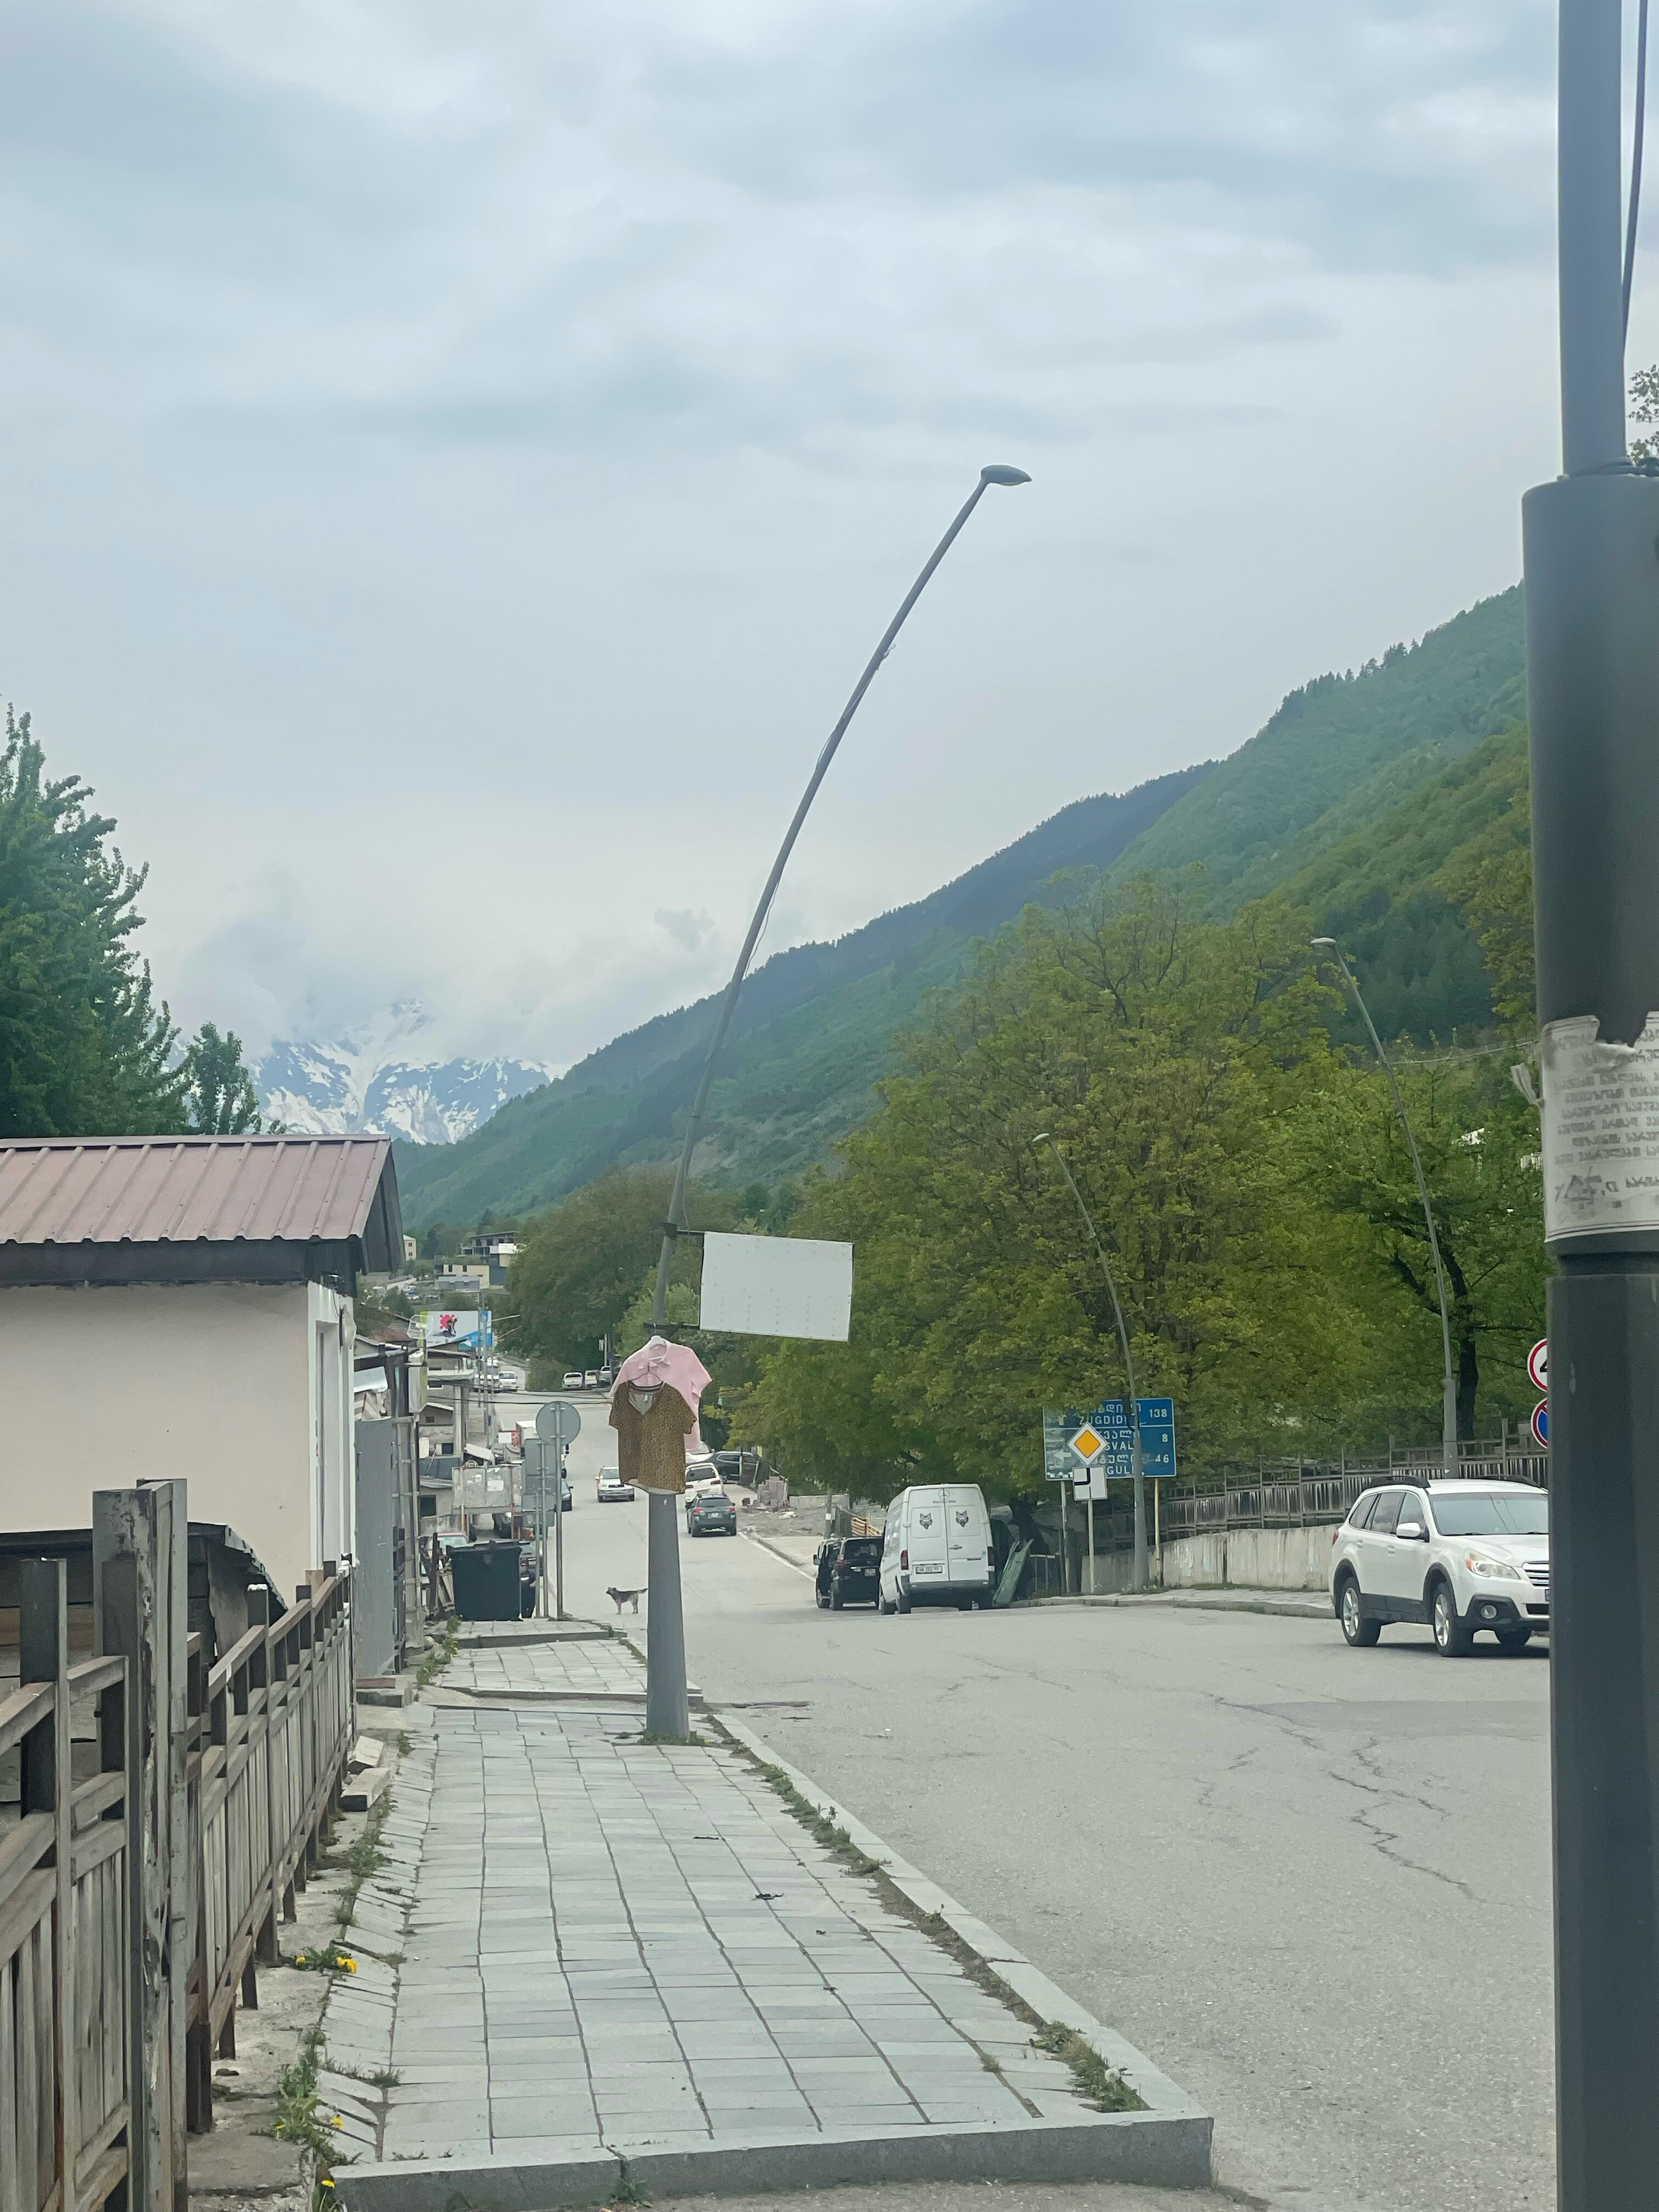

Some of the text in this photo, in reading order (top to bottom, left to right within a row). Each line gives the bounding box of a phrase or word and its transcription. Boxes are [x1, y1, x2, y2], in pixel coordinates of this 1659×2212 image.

[1149, 1408, 1167, 1418] 138
[1162, 1433, 1169, 1442] 8
[1155, 1454, 1170, 1463] 46
